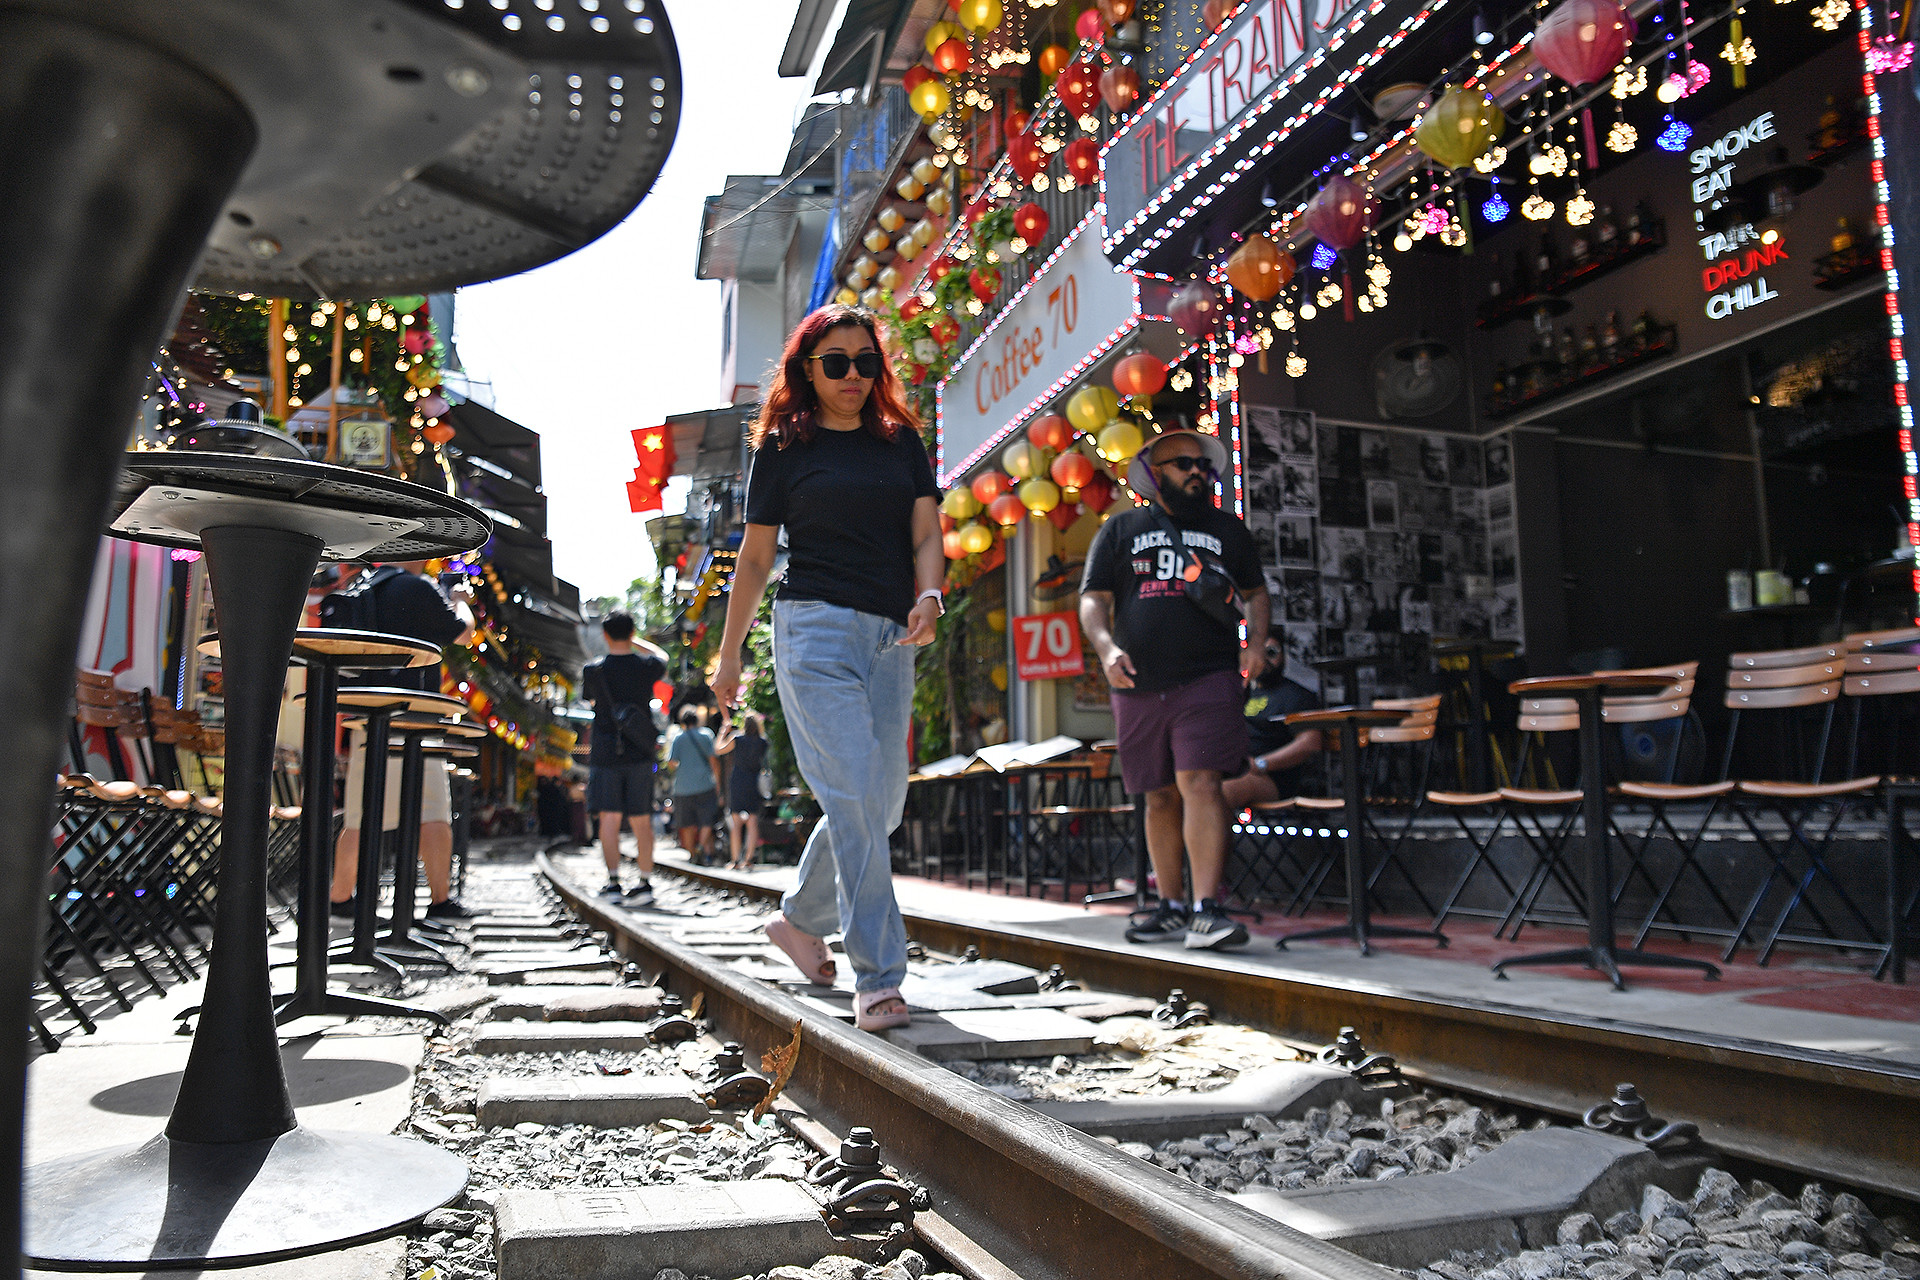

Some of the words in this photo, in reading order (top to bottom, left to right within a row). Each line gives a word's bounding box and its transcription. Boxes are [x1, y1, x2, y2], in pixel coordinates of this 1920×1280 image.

[1135, 87, 1190, 195] THE
[1200, 0, 1304, 134] TRAIN
[1689, 111, 1777, 174] SMOKE
[1692, 162, 1737, 203] EAT
[1702, 237, 1789, 293] DRUNK
[1706, 276, 1779, 320] CHILL
[975, 327, 1044, 415] Coffee
[1047, 273, 1078, 350] 70
[1021, 617, 1072, 660] 70
